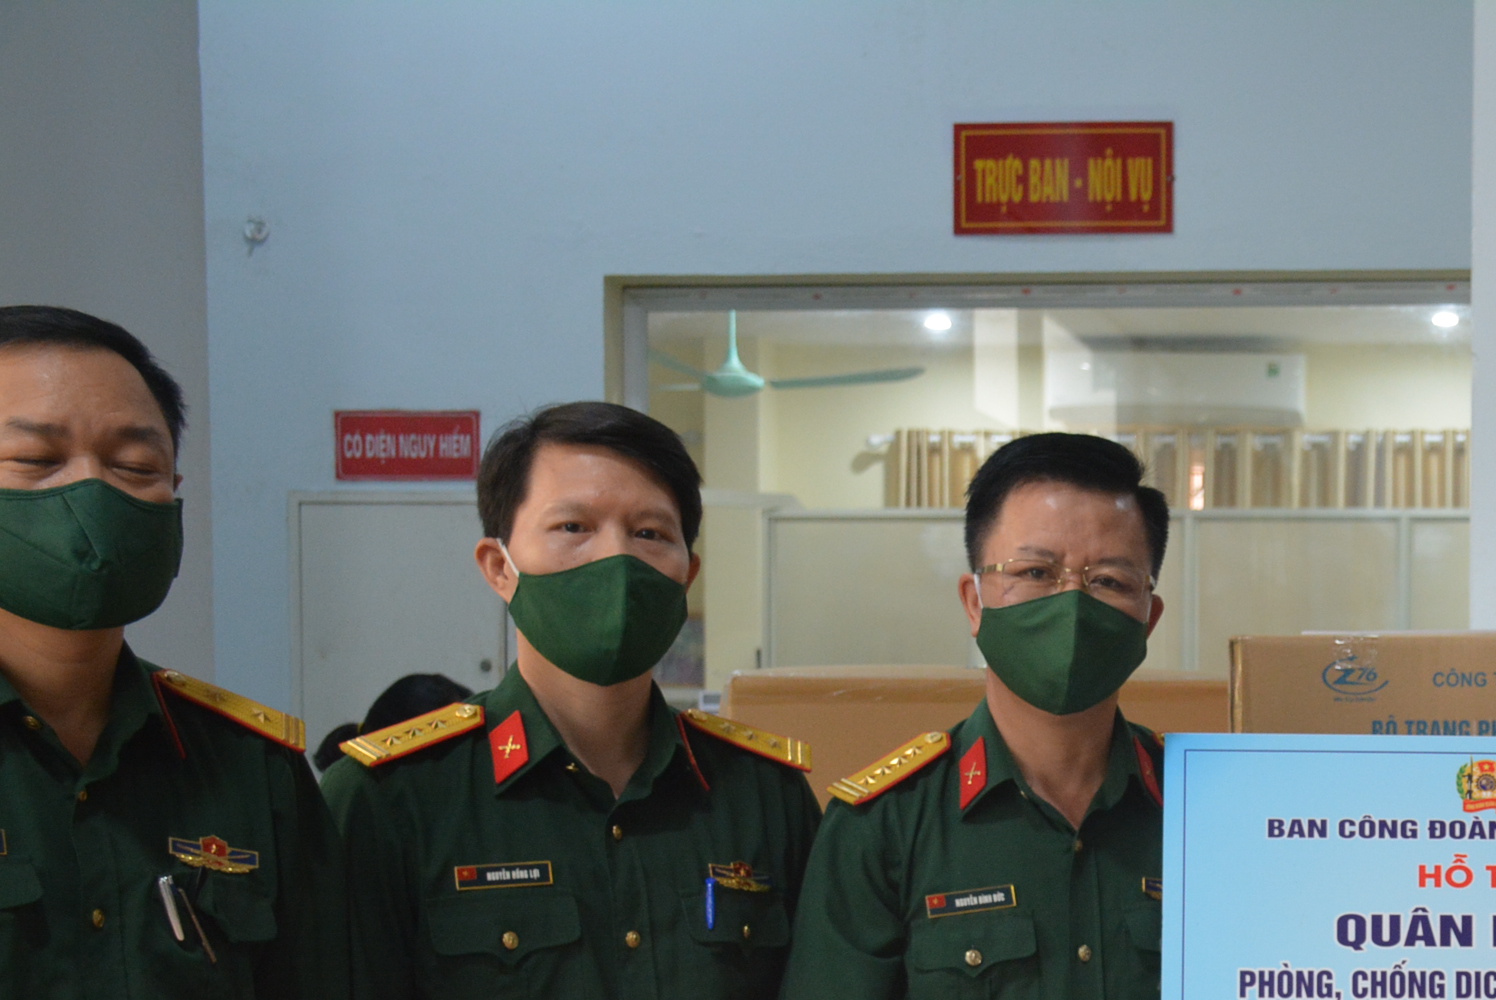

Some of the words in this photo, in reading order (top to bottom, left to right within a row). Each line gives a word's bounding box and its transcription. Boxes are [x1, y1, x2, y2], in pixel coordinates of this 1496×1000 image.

[973, 153, 1024, 214] TRỰC
[1029, 157, 1069, 203] BAN
[1088, 147, 1122, 213] NỘI
[1127, 156, 1153, 213] VỤ
[399, 434, 436, 459] NGUY
[1432, 667, 1488, 688] CÔNG
[1267, 818, 1328, 839] BAN
[1339, 815, 1418, 840] CÔNG
[1418, 853, 1474, 889] HỖ
[1336, 907, 1473, 950] QUÂN
[1352, 961, 1445, 1000] CHỐNG
